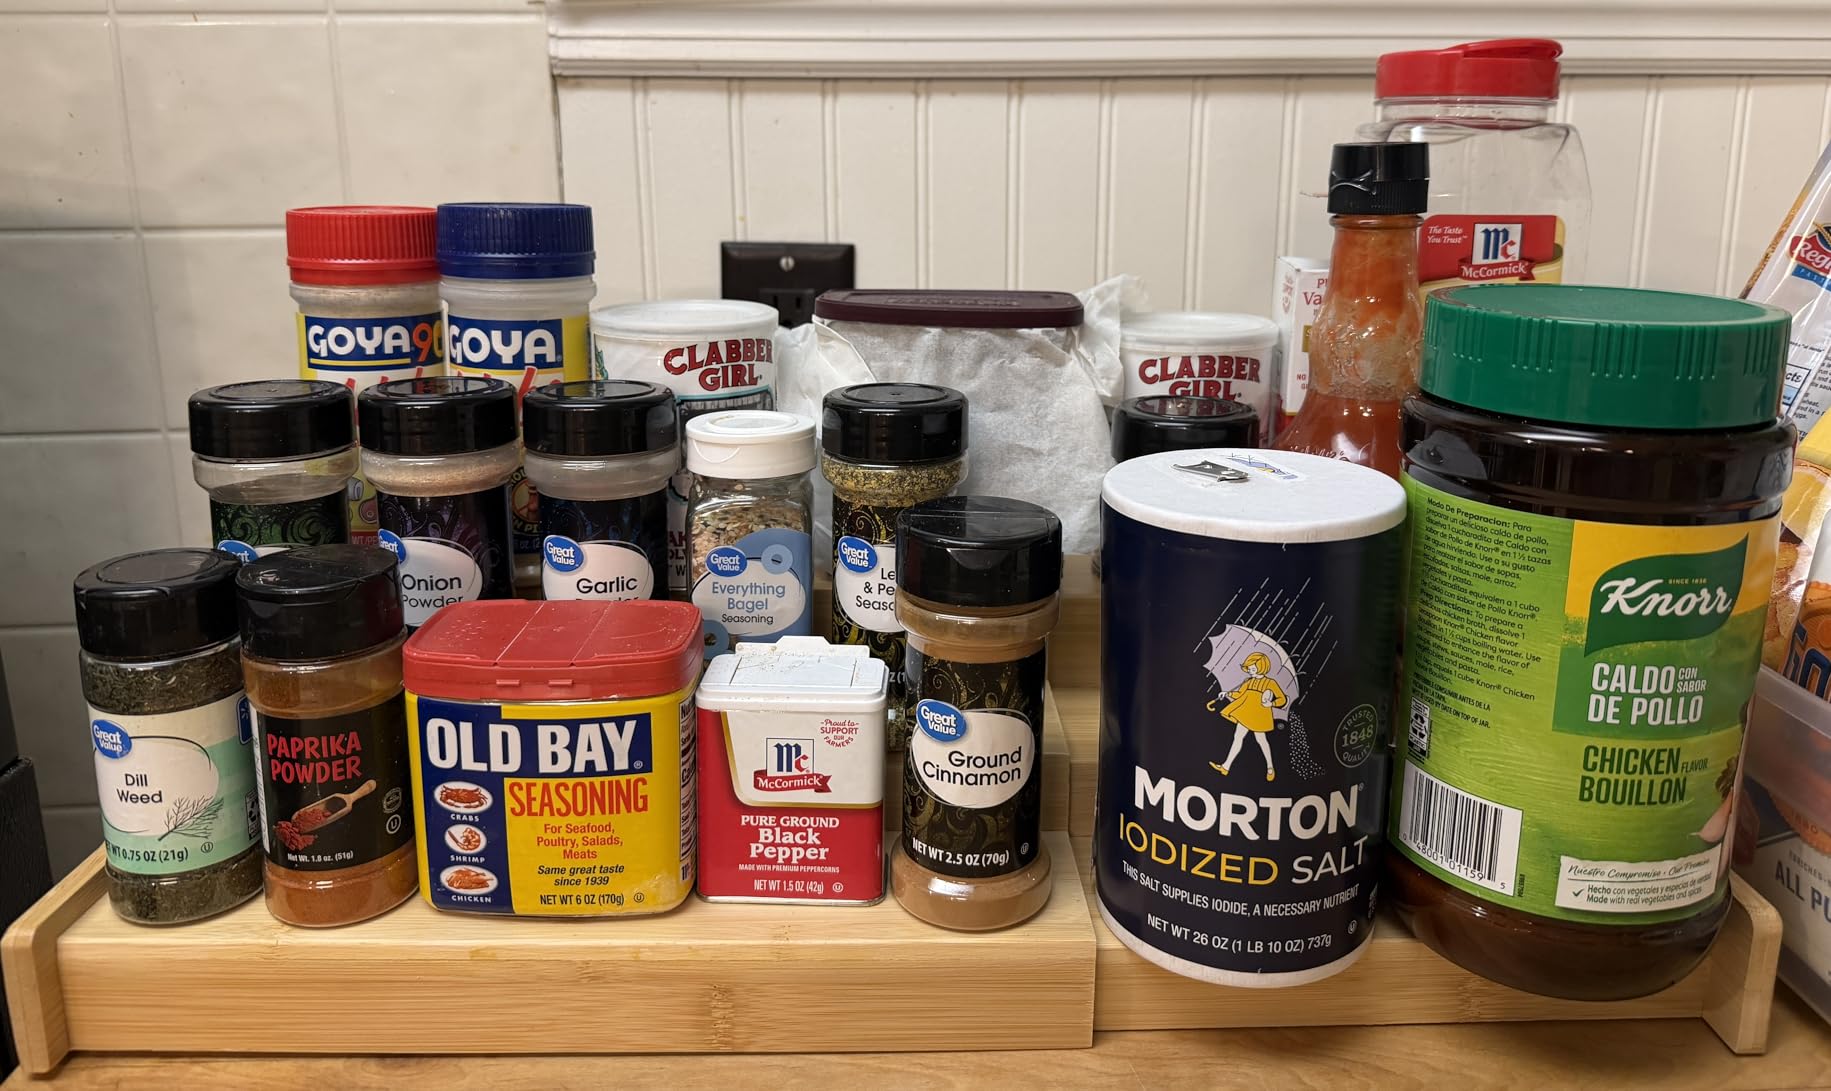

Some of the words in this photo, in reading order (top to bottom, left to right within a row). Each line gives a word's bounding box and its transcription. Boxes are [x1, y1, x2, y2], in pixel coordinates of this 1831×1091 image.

[1428, 226, 1442, 234] The
[1444, 226, 1463, 234] Taste
[1461, 262, 1527, 278] McCormick
[309, 325, 410, 357] GOYA
[450, 328, 556, 364] GOYA
[664, 339, 773, 375] CLABBER
[698, 364, 759, 391] GIRL
[1139, 355, 1260, 384] CLABBER
[1169, 380, 1236, 400] GIRL
[1457, 508, 1510, 528] Preparacion:
[547, 543, 574, 559] Great
[841, 543, 870, 560] Great
[1506, 540, 1529, 551] Caldo
[552, 554, 575, 566] Value
[710, 554, 740, 567] Great
[718, 563, 740, 572] Value
[846, 555, 869, 568] Value
[1528, 555, 1552, 565] tazas
[401, 574, 461, 590] Onion
[577, 577, 637, 594] Garlic
[712, 582, 785, 598] Everything
[864, 583, 873, 595] &
[1600, 577, 1730, 617] Knorr
[728, 598, 768, 613] Bagel
[722, 614, 774, 625] Seasoning
[1592, 662, 1675, 694] CALDO
[1679, 668, 1697, 680] CON
[1503, 686, 1535, 700] Chicken
[1676, 680, 1706, 694] SABOR
[921, 706, 957, 728] Great
[1588, 694, 1622, 724] DE
[1630, 695, 1704, 726] POLLO
[928, 720, 957, 735] Value
[1343, 711, 1374, 731] TRUSTED
[94, 726, 122, 745] Great
[824, 736, 853, 748] FARMERS
[1342, 724, 1374, 747] 1848
[99, 740, 122, 752] Value
[267, 732, 362, 759] PAPRIKA
[426, 718, 522, 773] OLD
[537, 720, 636, 773] BAY
[1343, 743, 1371, 763] QUALITY
[949, 746, 1022, 767] Ground
[1582, 744, 1681, 775] CHICKEN
[271, 756, 362, 784] POWDER
[1681, 757, 1708, 773] FLAVOR
[125, 774, 148, 786] Dill
[757, 775, 822, 789] McCormick
[923, 762, 1021, 787] Cinnamon
[117, 789, 162, 804] Weed
[509, 777, 648, 816] SEASONING
[1579, 775, 1687, 806] BOUILLON
[1134, 765, 1358, 840] MORTON
[451, 814, 479, 822] CRABS
[741, 815, 776, 826] PURE
[780, 816, 839, 828] GROUND
[544, 824, 562, 834] For
[565, 823, 615, 834] Seafood,
[759, 828, 821, 844] Black
[537, 836, 578, 848] Poultry,
[582, 836, 623, 847] Salads,
[1119, 813, 1278, 885] IODIZED
[1291, 835, 1368, 884] SALT
[112, 846, 120, 855] WT
[122, 850, 141, 860] 0.75
[144, 851, 156, 861] OZ
[160, 847, 188, 863] (21g)
[335, 851, 353, 862] (51g)
[450, 855, 485, 863] SHRIMP
[563, 849, 597, 859] Meats
[750, 843, 829, 864] Pepper
[913, 837, 926, 856] NET
[928, 846, 944, 862] WT
[946, 851, 962, 865] 2.5
[966, 854, 980, 866] OZ
[981, 850, 1010, 868] (70g)
[772, 864, 799, 872] PREMIUM
[800, 865, 839, 873] PEPPERCORNS
[1416, 842, 1444, 864] 48001
[1449, 860, 1484, 881] 01159
[538, 865, 566, 875] Same
[569, 865, 595, 877] great
[598, 864, 624, 874] taste
[1568, 865, 1605, 877] Nuestro
[1668, 866, 1683, 876] Our
[554, 876, 581, 886] since
[584, 876, 609, 886] 1939
[754, 880, 767, 890] NET
[768, 880, 780, 891] WT
[783, 881, 794, 891] 1.5
[795, 881, 804, 892] OZ
[806, 881, 824, 894] (42g)
[1122, 860, 1138, 882] THIS
[1140, 875, 1159, 892] SALT
[1162, 883, 1209, 909] SUPPLIES
[1212, 896, 1250, 917] IODIDE,
[1253, 904, 1261, 916] A
[1264, 899, 1321, 916] NECESSARY
[1323, 883, 1359, 910] NUTRIENT
[1776, 860, 1804, 901] ALL
[1586, 895, 1608, 904] Made
[1610, 895, 1625, 904] with
[1626, 895, 1640, 904] real
[1641, 892, 1675, 906] vegetables
[1676, 889, 1686, 899] and
[1588, 885, 1611, 895] Hecho
[1612, 887, 1626, 895] con
[1627, 886, 1659, 896] vegetales
[452, 895, 491, 903] CHICKEN
[540, 895, 556, 904] NET
[558, 894, 573, 904] WT
[576, 894, 581, 903] 6
[583, 894, 595, 904] OZ
[598, 894, 624, 906] (170g)
[1148, 913, 1168, 933] NET
[1171, 924, 1190, 941] WT
[1193, 931, 1208, 946] 26
[1213, 936, 1228, 950] OZ
[1232, 940, 1241, 953] (1
[1247, 940, 1263, 952] LB
[1267, 941, 1281, 953] 10
[1285, 939, 1305, 953] OZ)
[1307, 935, 1331, 950] 737g
